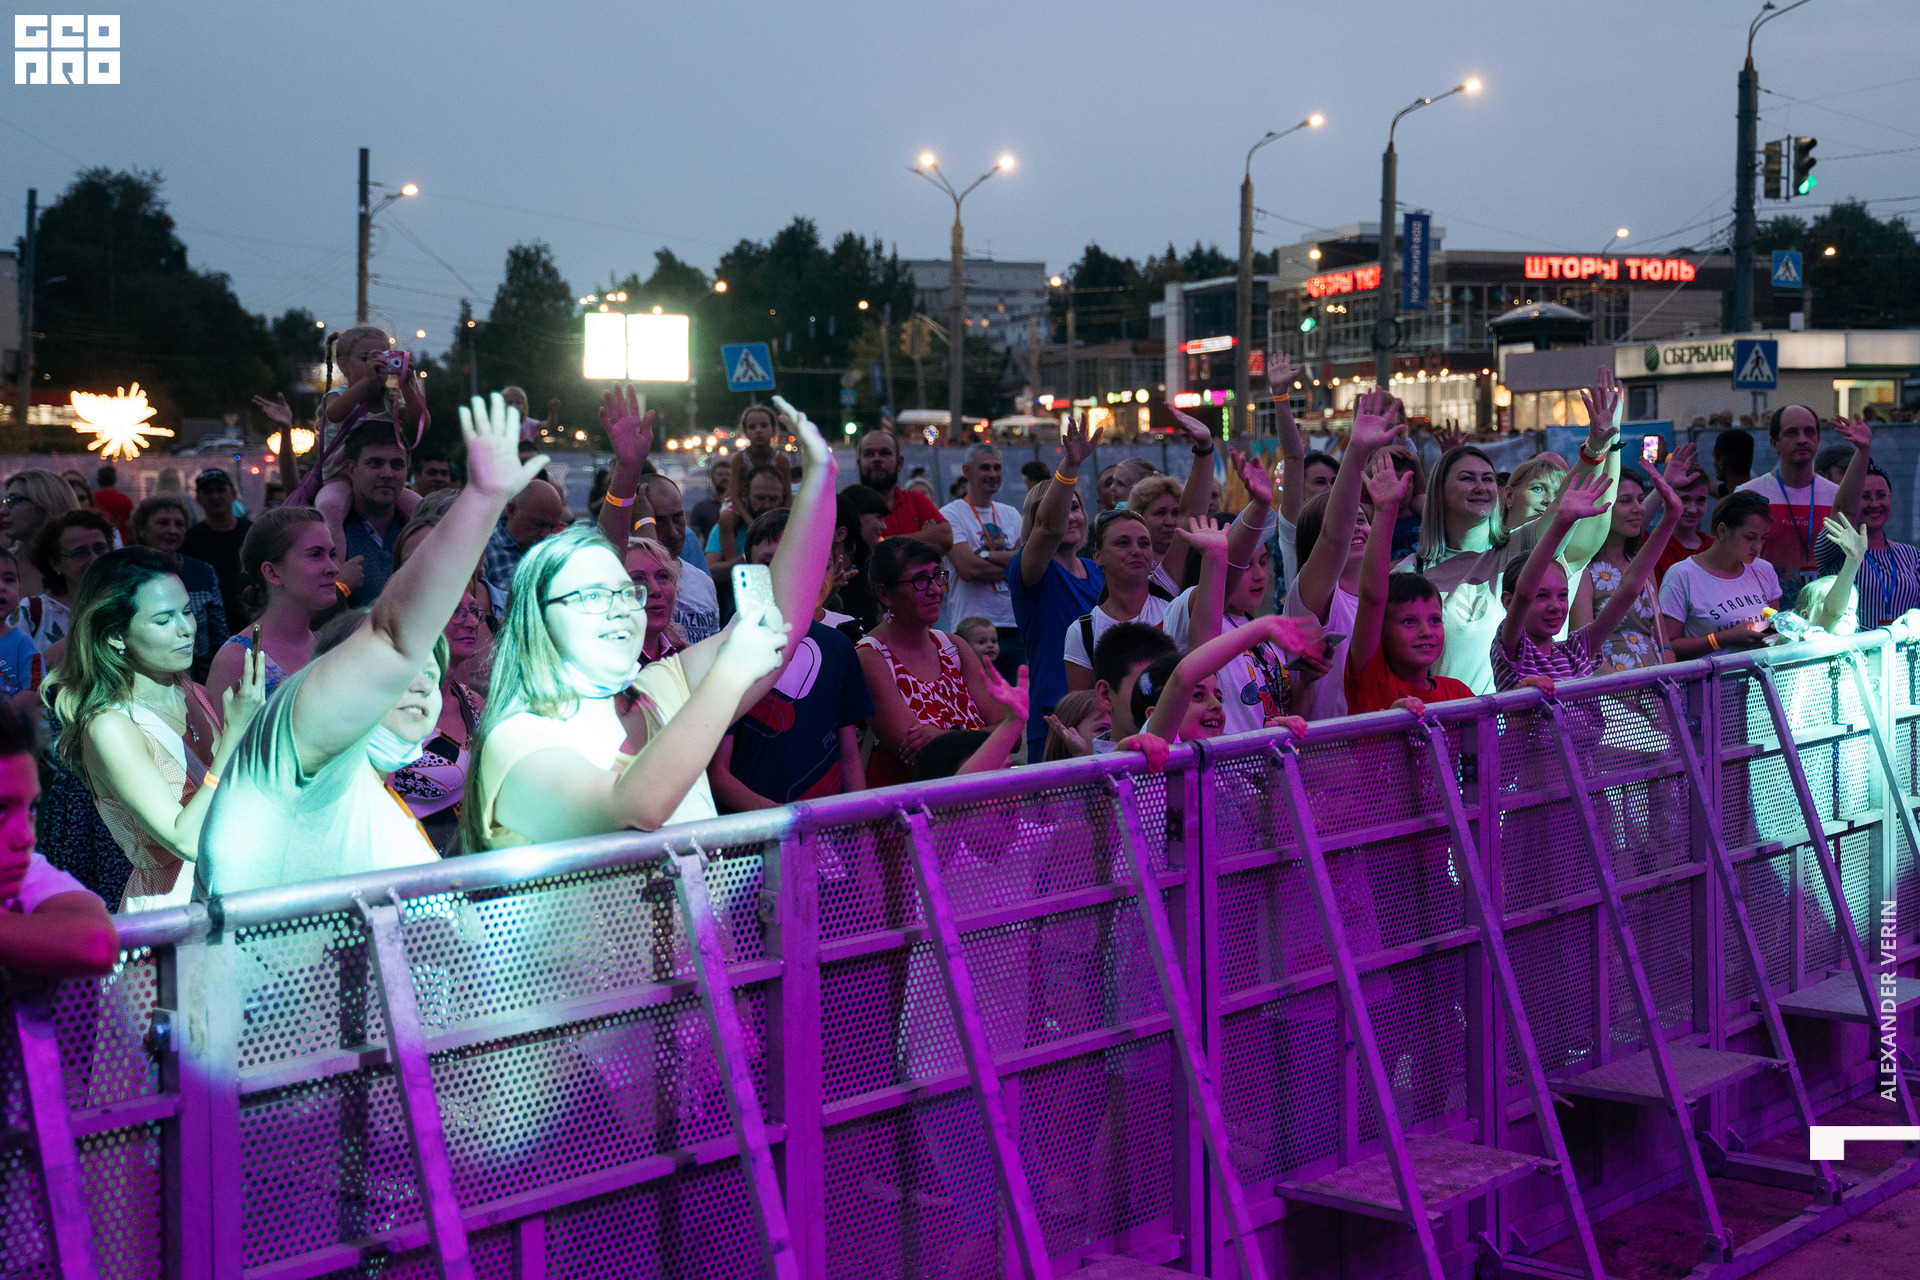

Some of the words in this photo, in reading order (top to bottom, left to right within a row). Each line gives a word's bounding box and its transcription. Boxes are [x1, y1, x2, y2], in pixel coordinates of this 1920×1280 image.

[1525, 256, 1619, 281] ШТОРЫ
[1625, 257, 1696, 282] ТЮЛЬ
[1664, 344, 1735, 366] СБЕРБАНК
